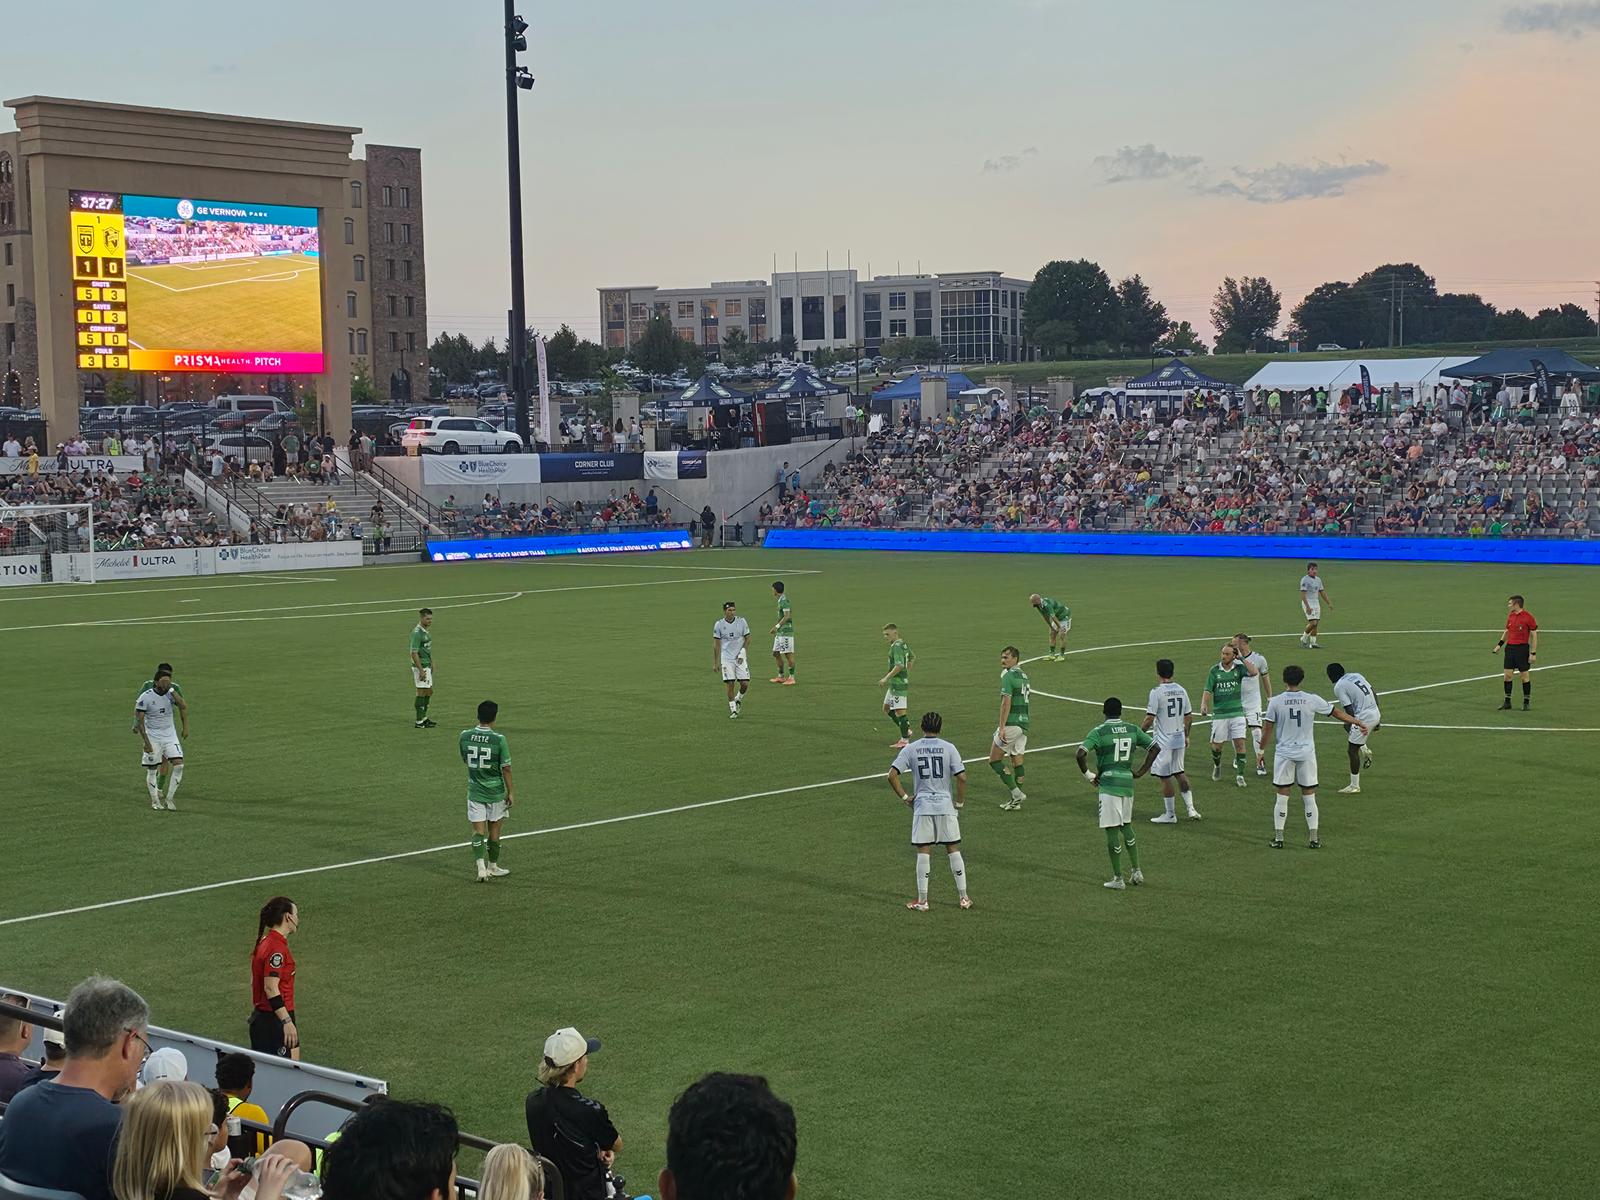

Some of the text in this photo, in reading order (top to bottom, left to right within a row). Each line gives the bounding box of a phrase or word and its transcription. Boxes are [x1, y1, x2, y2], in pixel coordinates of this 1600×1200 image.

[80, 196, 114, 210] 37:27
[196, 206, 208, 215] GE
[209, 207, 247, 217] VERNOVA
[96, 215, 101, 224] 1
[84, 261, 91, 273] 1
[109, 262, 118, 274] 0
[85, 289, 93, 300] 5
[111, 290, 118, 301] 3
[86, 312, 93, 322] 0
[111, 313, 119, 323] 3
[86, 334, 94, 345] 5
[112, 334, 119, 345] 0
[88, 356, 95, 367] 3
[113, 356, 120, 367] 3
[174, 354, 221, 366] PRISMA
[254, 357, 281, 366] PITCH
[70, 459, 114, 470] ULTRA
[574, 460, 599, 468] CORNER
[141, 556, 176, 566] ULTRA
[0, 564, 38, 576] TION
[1354, 680, 1370, 696] 6
[1167, 698, 1183, 718] 21
[1289, 708, 1301, 727] 4
[1113, 738, 1131, 762] 19
[467, 745, 492, 769] 22
[917, 756, 944, 779] 20
